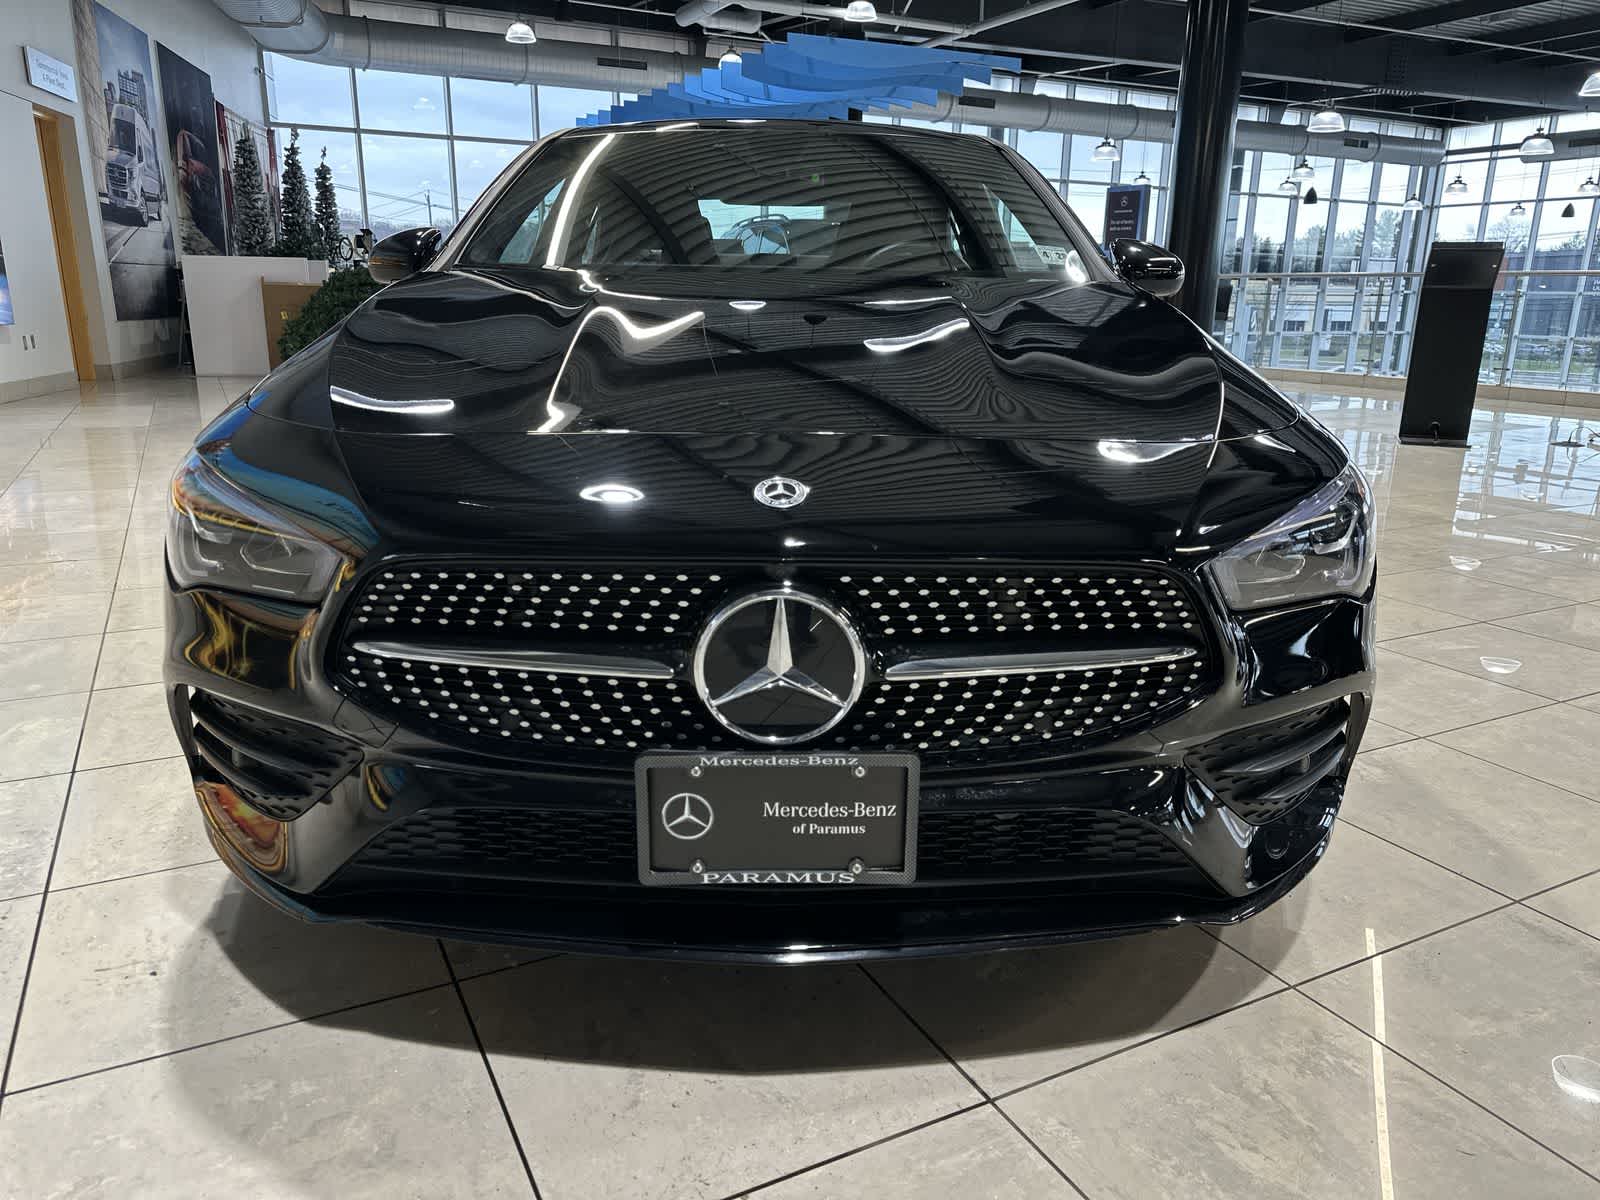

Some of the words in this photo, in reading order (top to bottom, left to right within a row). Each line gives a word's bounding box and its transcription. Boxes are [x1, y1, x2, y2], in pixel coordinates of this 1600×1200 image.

[700, 755, 859, 767] Mercedes-Benz
[763, 801, 897, 818] Mercedes-Benz
[792, 823, 807, 834] of
[808, 823, 866, 834] Paramus
[701, 872, 856, 884] PARAMUS
